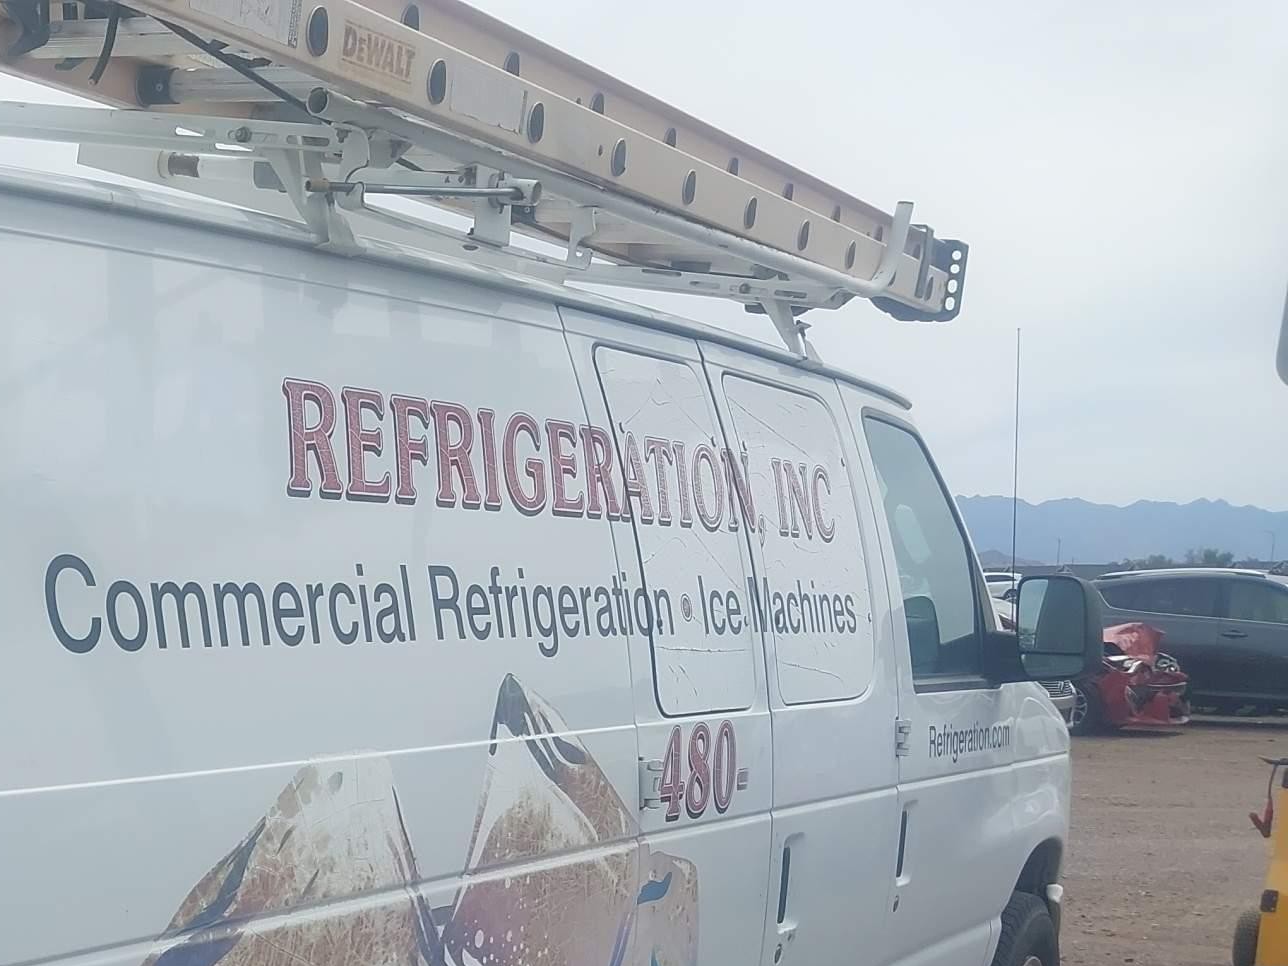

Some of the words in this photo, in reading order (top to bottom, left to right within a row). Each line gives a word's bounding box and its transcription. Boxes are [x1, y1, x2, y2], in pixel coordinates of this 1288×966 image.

[283, 376, 767, 549] REFRIGERATION,
[771, 457, 836, 543] INC
[45, 544, 416, 654] Commercial
[427, 565, 675, 659] Refrigeration
[697, 575, 742, 635] Ice
[746, 576, 857, 635] Machines
[929, 722, 1010, 763] Refrigeration.com
